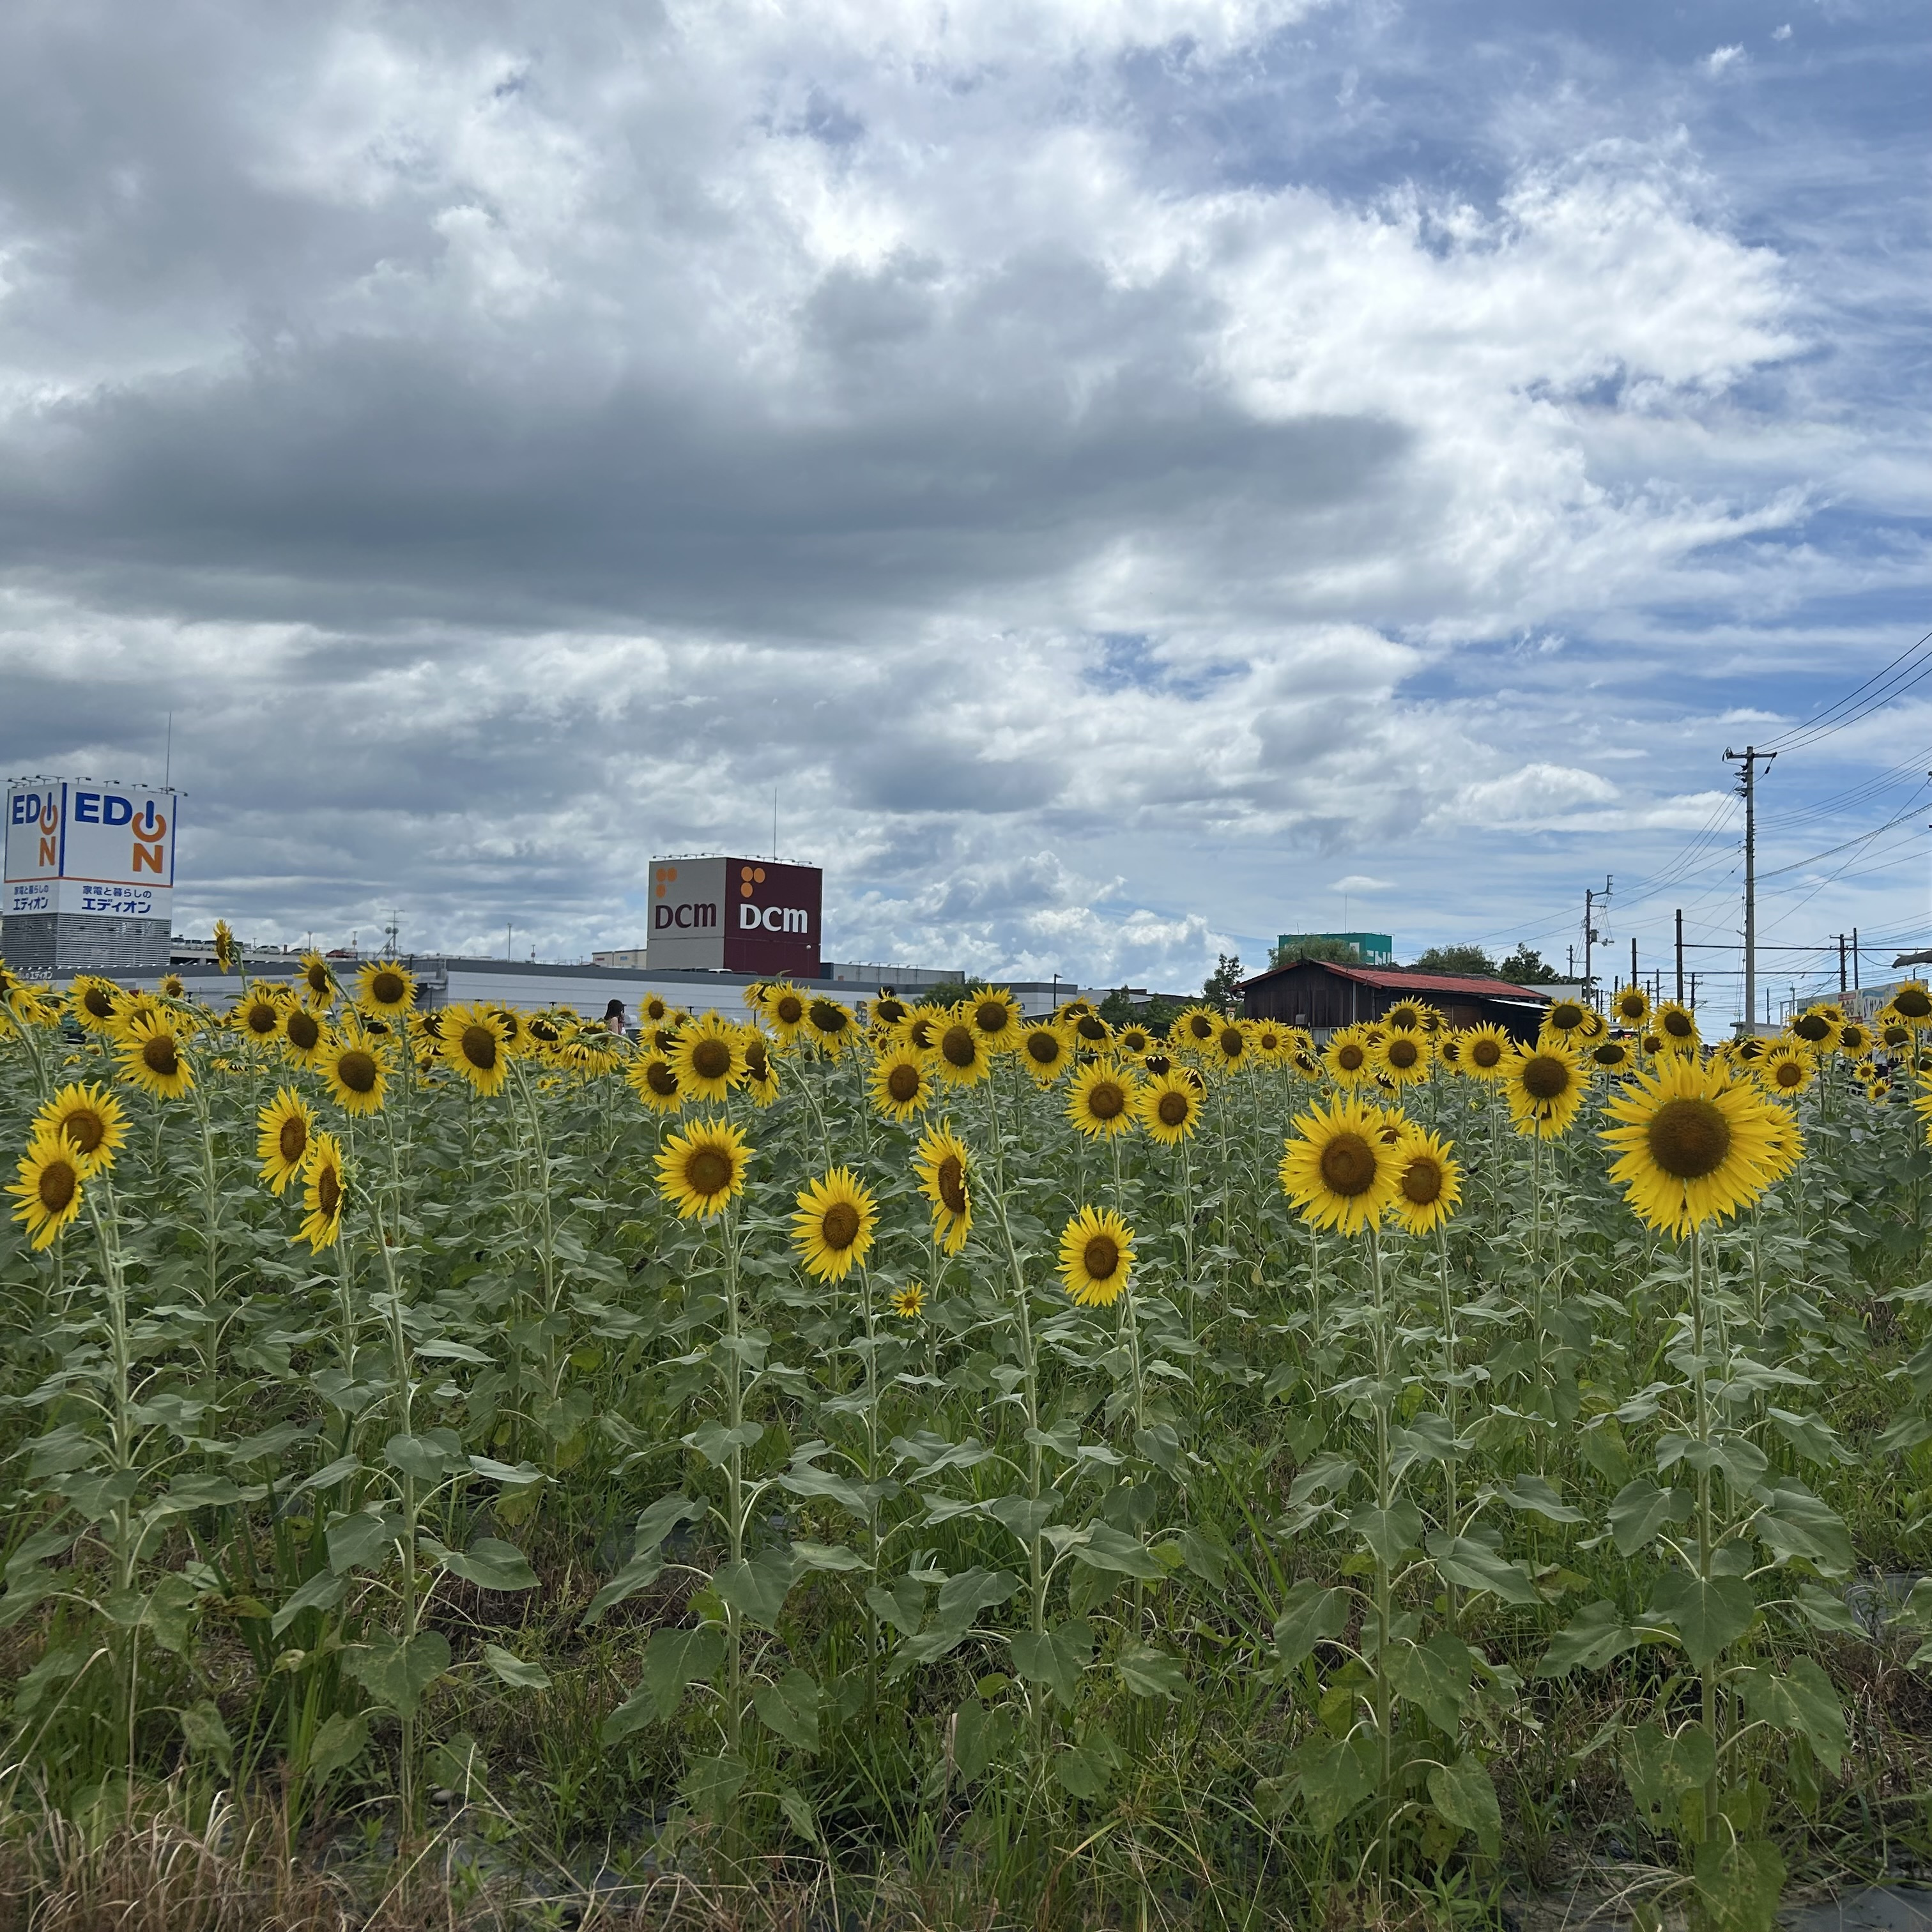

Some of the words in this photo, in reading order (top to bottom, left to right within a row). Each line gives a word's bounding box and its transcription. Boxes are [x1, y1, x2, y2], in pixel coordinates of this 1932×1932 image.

[75, 792, 166, 873] EDION
[14, 885, 49, 895] 家電と暮らしの
[82, 885, 151, 898] 家電と暮らしの
[13, 896, 49, 910] エディオン
[81, 898, 151, 914] エディオン
